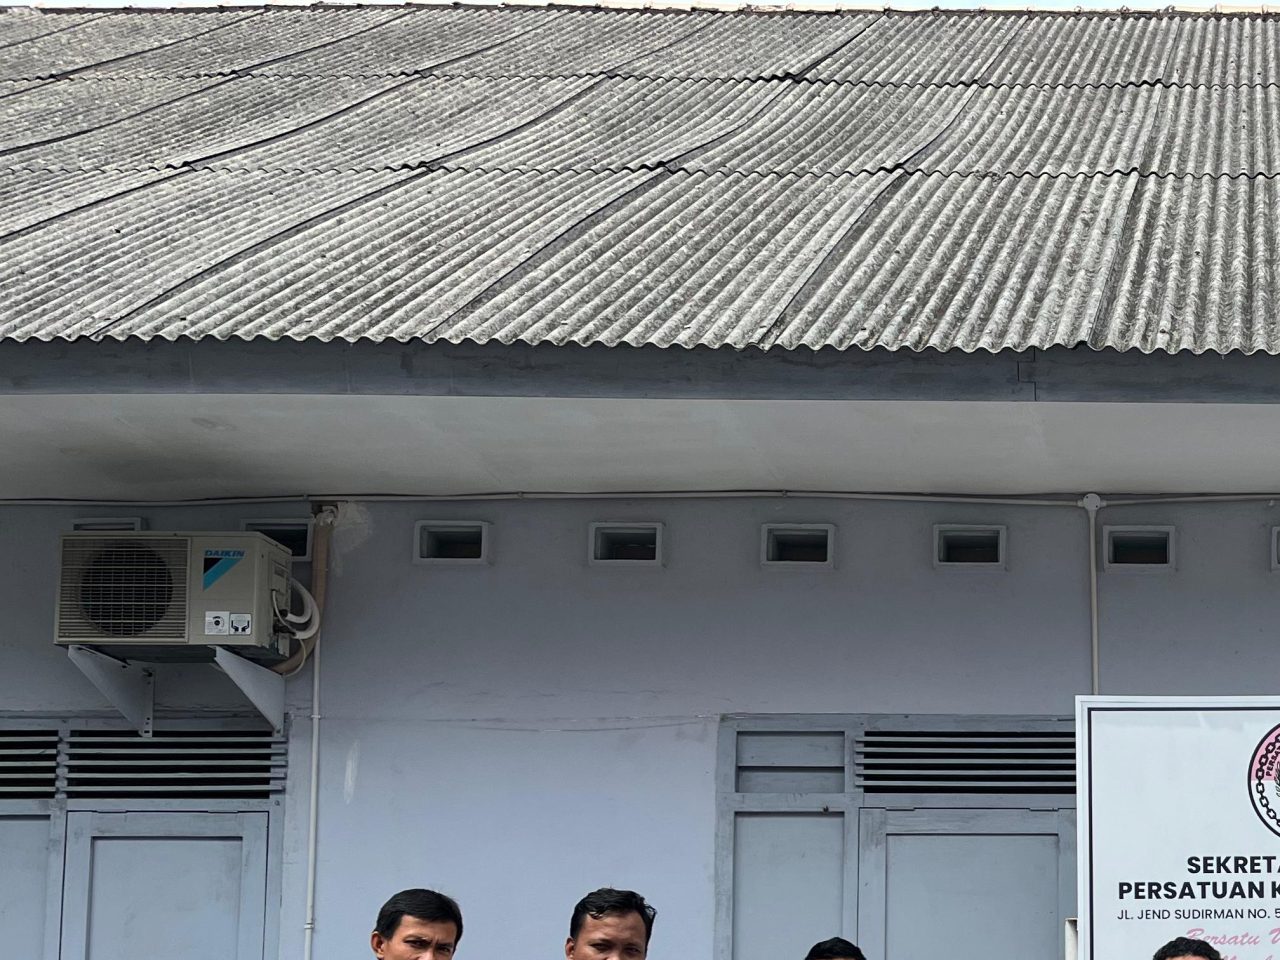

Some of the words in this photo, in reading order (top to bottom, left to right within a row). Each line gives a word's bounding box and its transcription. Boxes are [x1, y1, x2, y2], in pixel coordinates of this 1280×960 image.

[204, 549, 245, 557] DAIKIN
[1118, 881, 1265, 900] PERSATUAN
[1117, 909, 1133, 920] JL.
[1137, 909, 1171, 920] JEND
[1174, 908, 1244, 919] SUDIRMAN
[1247, 908, 1270, 919] NO.
